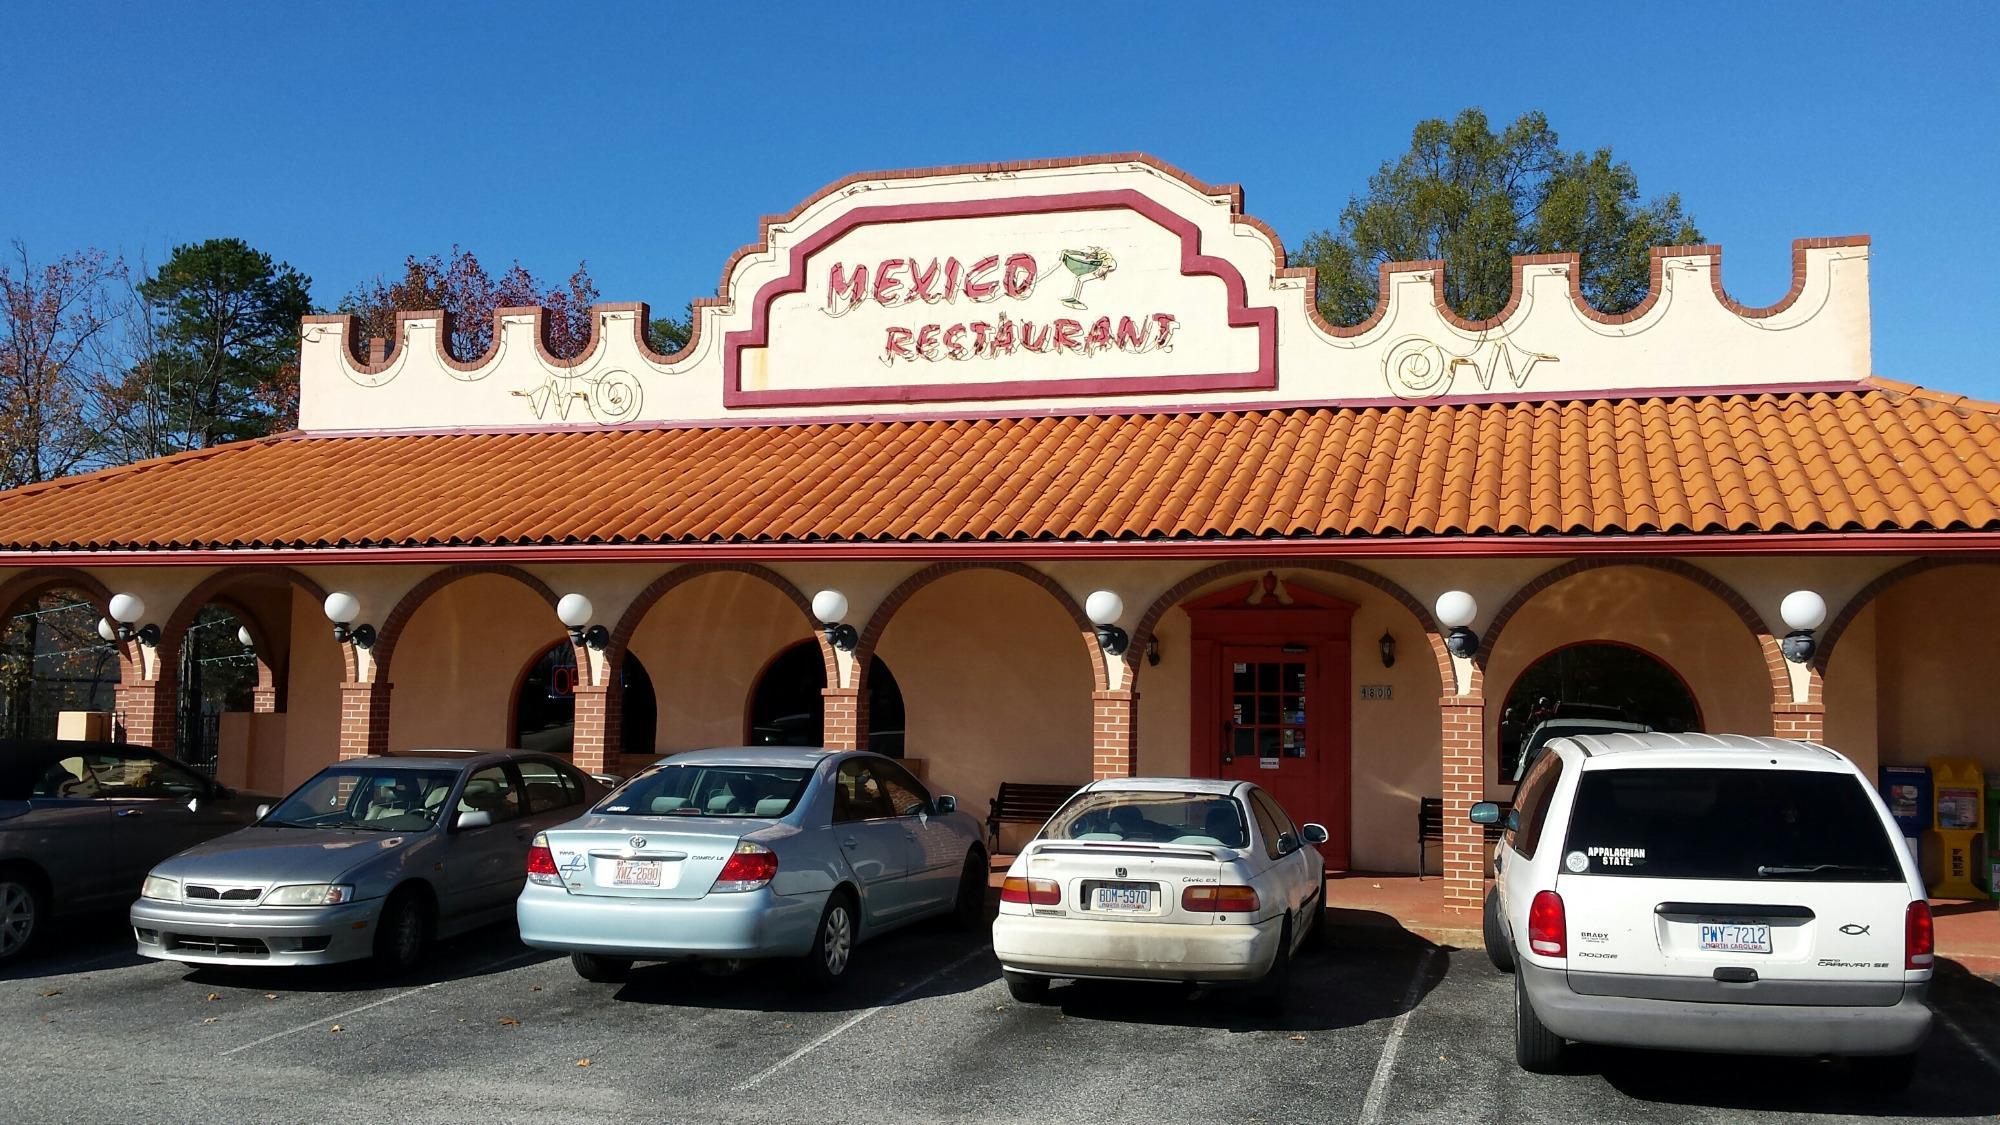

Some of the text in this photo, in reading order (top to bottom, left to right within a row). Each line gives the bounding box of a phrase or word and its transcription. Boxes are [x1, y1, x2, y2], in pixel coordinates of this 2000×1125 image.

[826, 253, 1039, 313] MEXICO
[882, 312, 1178, 363] RESTAURANT
[1361, 687, 1393, 698] 4800
[1587, 847, 1646, 859] APPALACHIAN
[1099, 889, 1148, 904] BDM-5970
[1702, 926, 1766, 944] PWY-7212
[1730, 943, 1764, 951] CAROLINA
